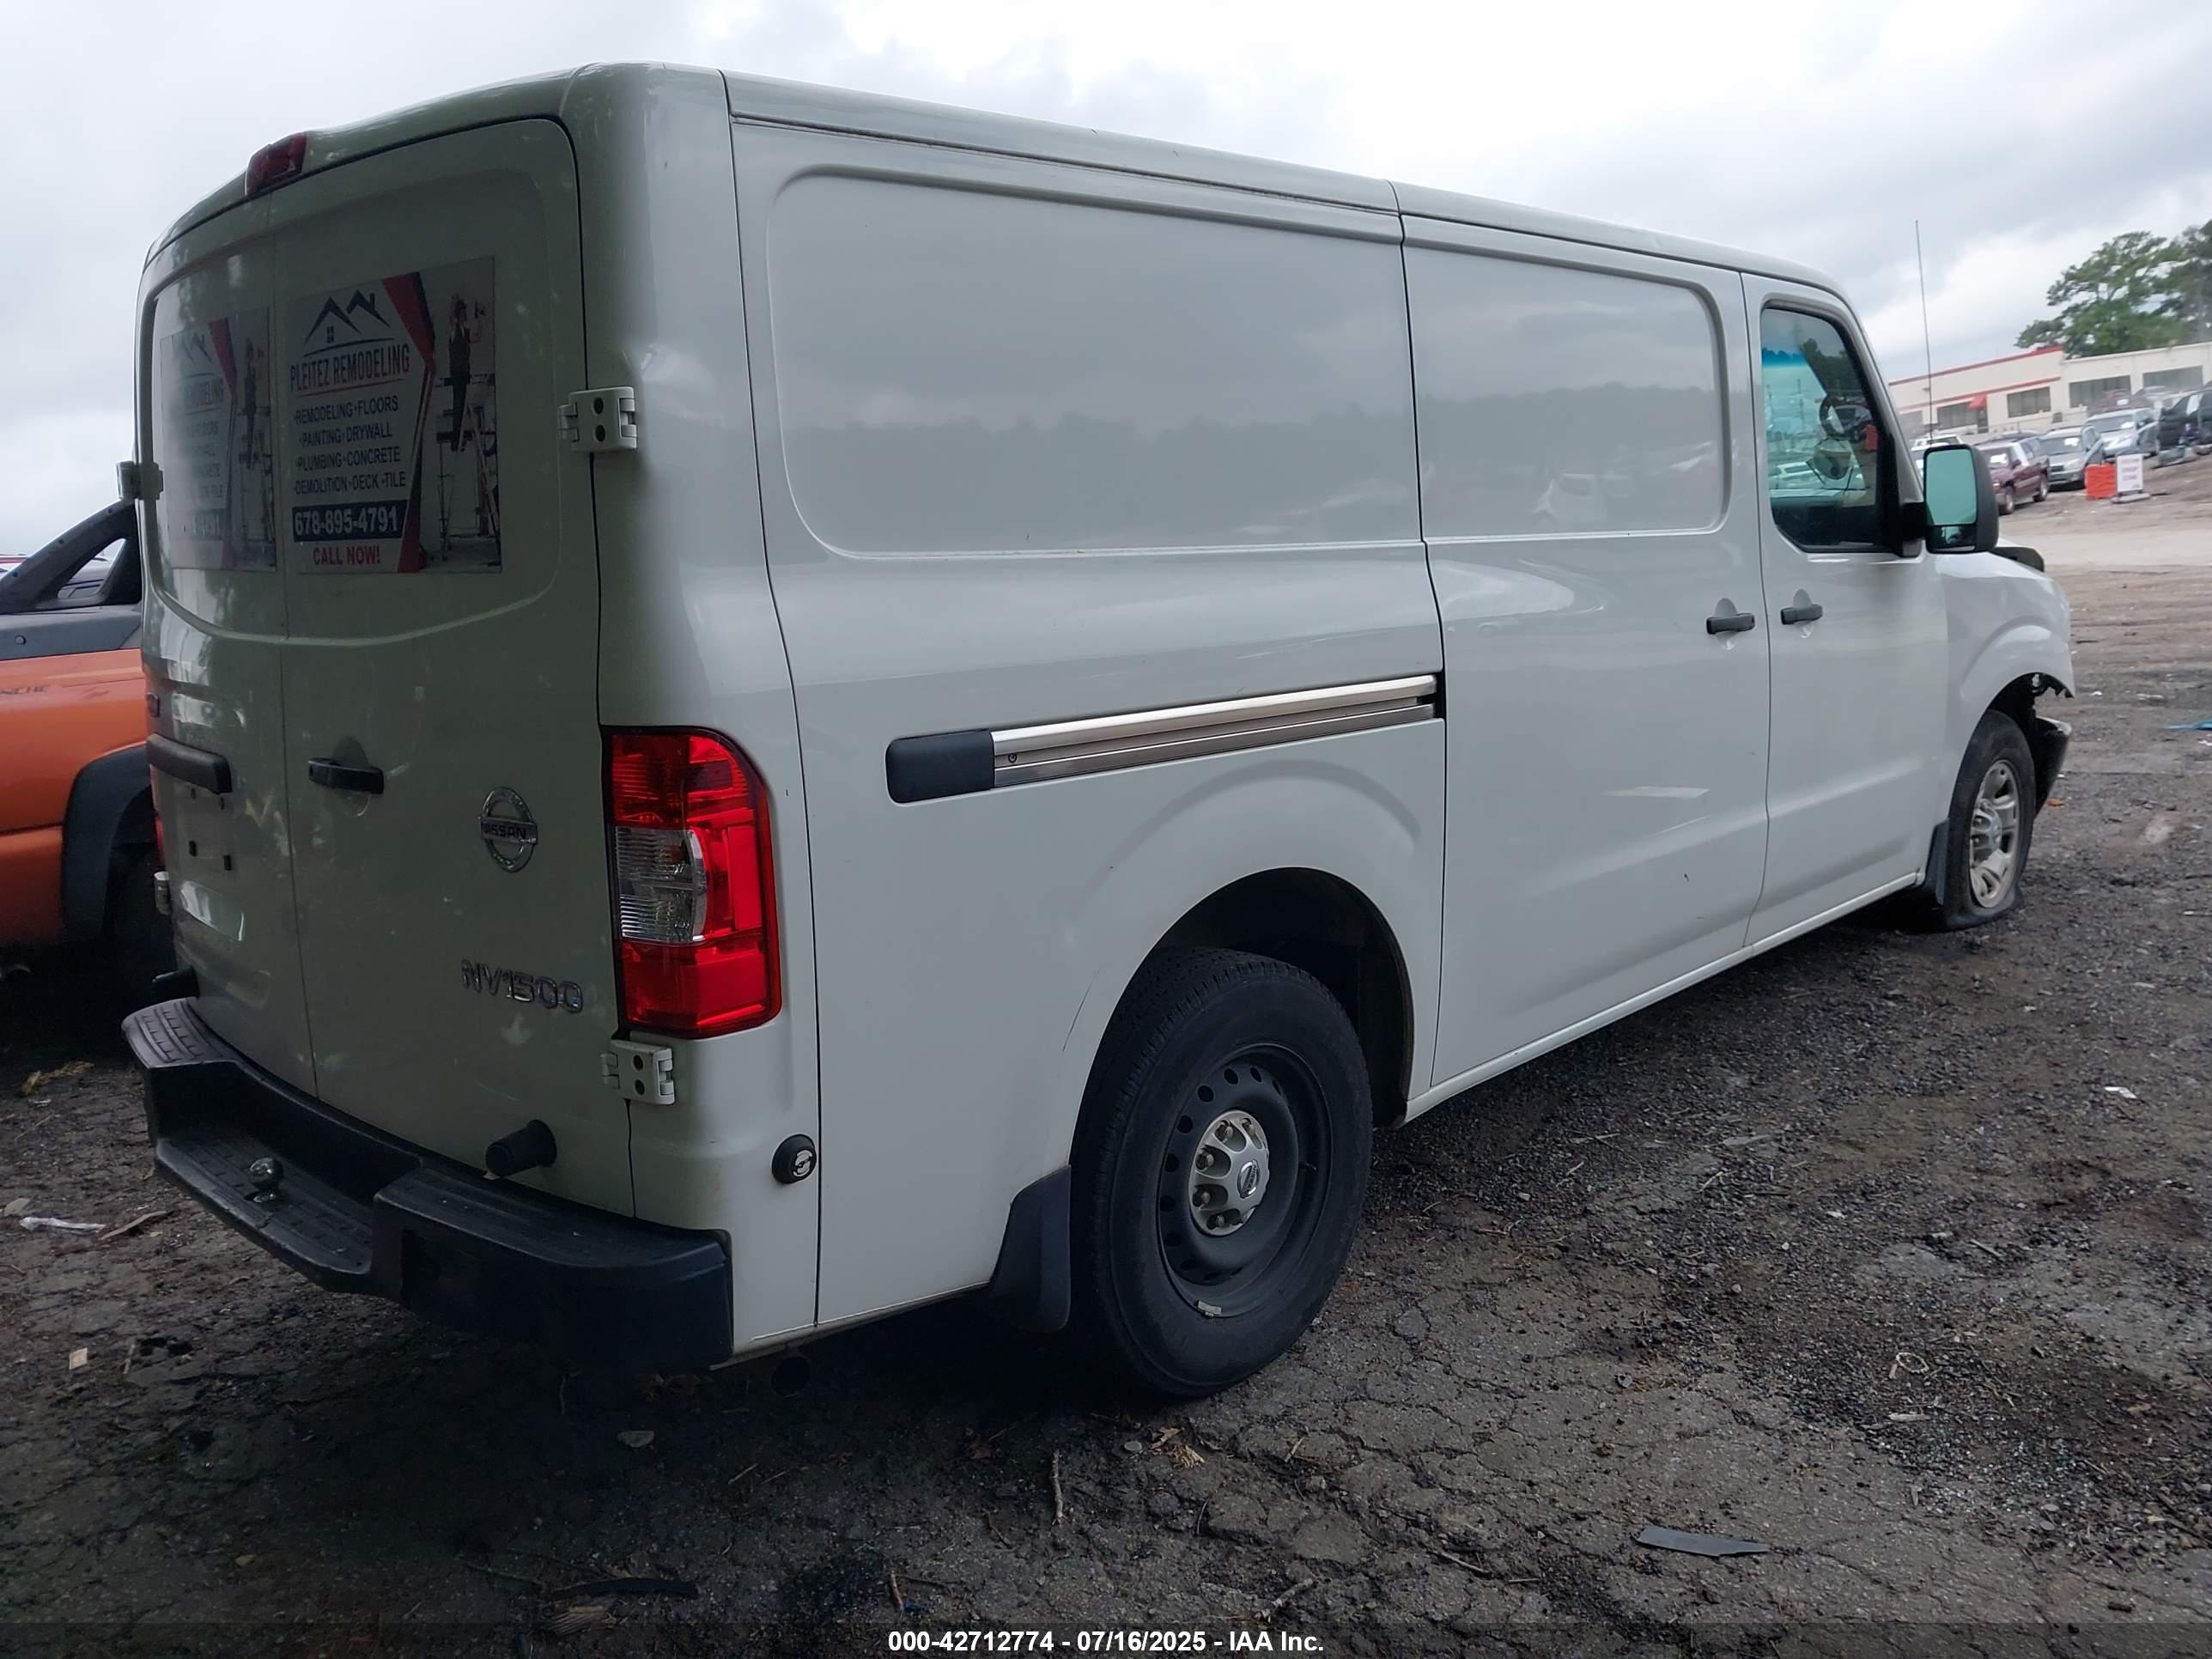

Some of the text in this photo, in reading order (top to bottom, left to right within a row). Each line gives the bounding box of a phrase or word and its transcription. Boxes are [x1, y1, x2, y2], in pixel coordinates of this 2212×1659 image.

[290, 343, 410, 392] PLEITEZ REMODELING
[295, 505, 398, 536] 678-895-4791
[313, 545, 380, 566] CALL NOW!
[461, 958, 584, 1014] NV1500
